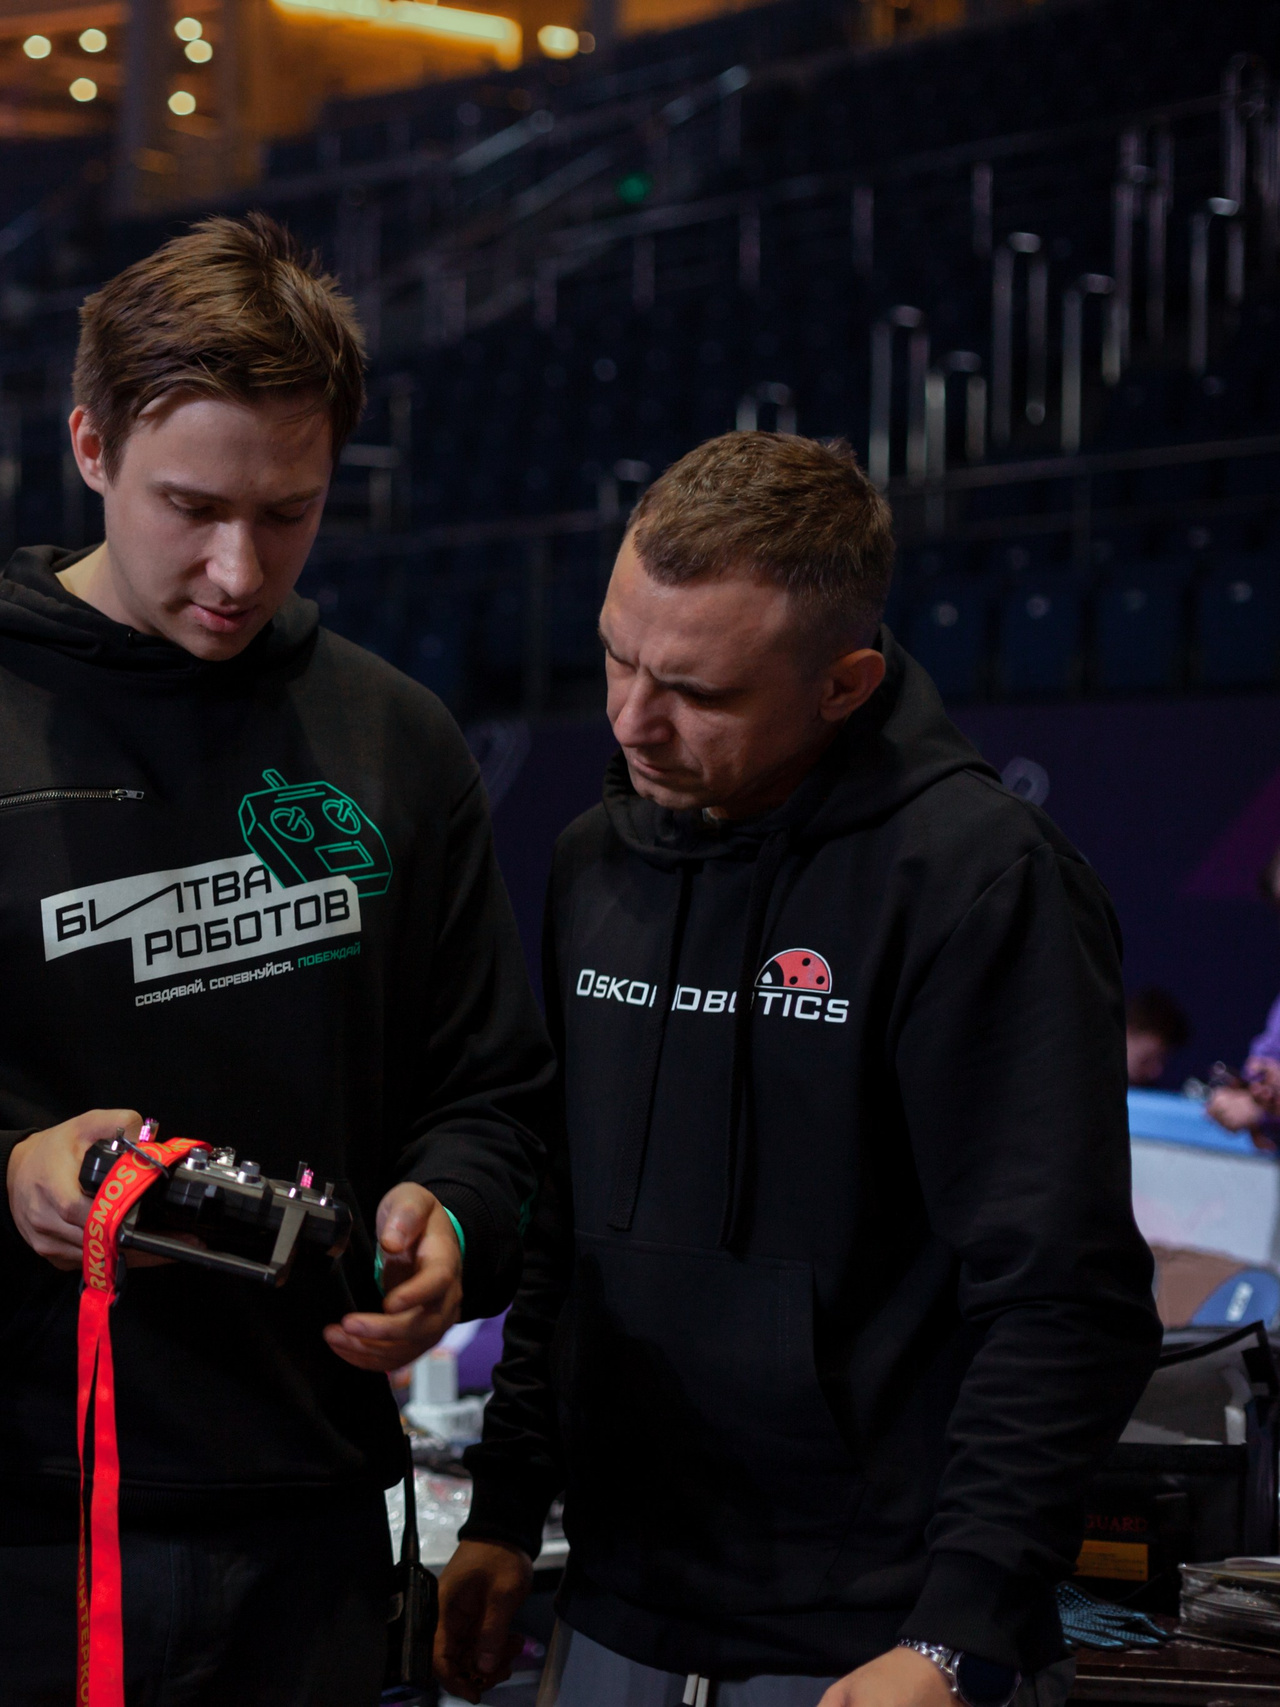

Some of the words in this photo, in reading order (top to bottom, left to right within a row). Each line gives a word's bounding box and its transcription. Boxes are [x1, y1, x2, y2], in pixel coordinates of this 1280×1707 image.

[55, 864, 272, 942] БИТВА
[144, 888, 351, 965] РОБОТОВ
[135, 979, 206, 1007] СОЗДАВАЙ.
[209, 960, 294, 990] СОРЕВНУЙСЯ.
[297, 942, 361, 969] ПОБЕЖДАЙ
